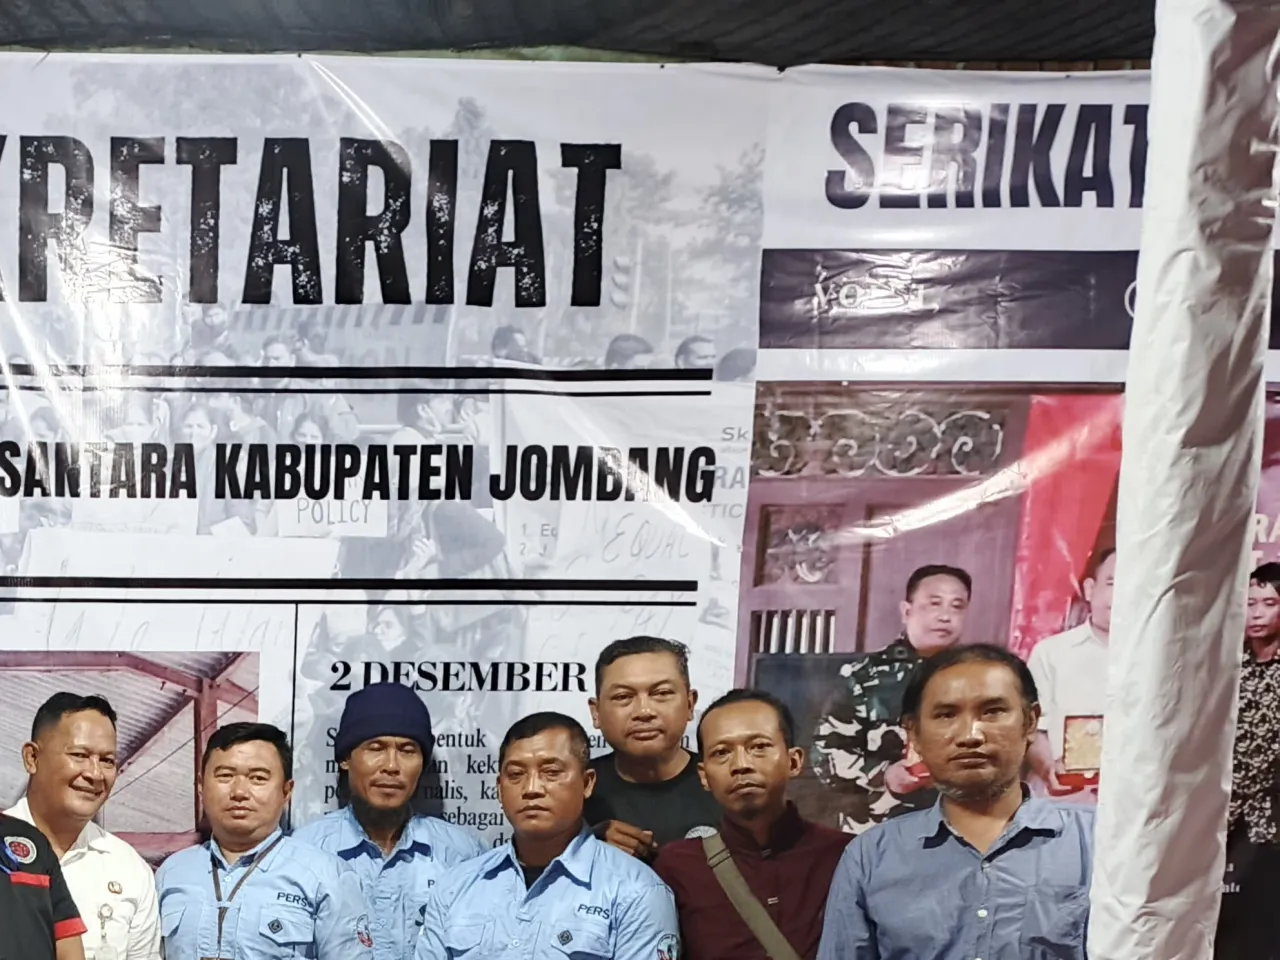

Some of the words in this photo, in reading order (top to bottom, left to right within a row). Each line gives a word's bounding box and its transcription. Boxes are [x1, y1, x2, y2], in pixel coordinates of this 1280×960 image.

[215, 443, 473, 501] KABUPATEN
[489, 443, 716, 503] JOMBANG
[297, 497, 371, 525] POLICY
[330, 661, 352, 691] 2
[362, 661, 588, 692] DESEMBER
[277, 892, 308, 907] PERS
[577, 903, 610, 920] PERS
